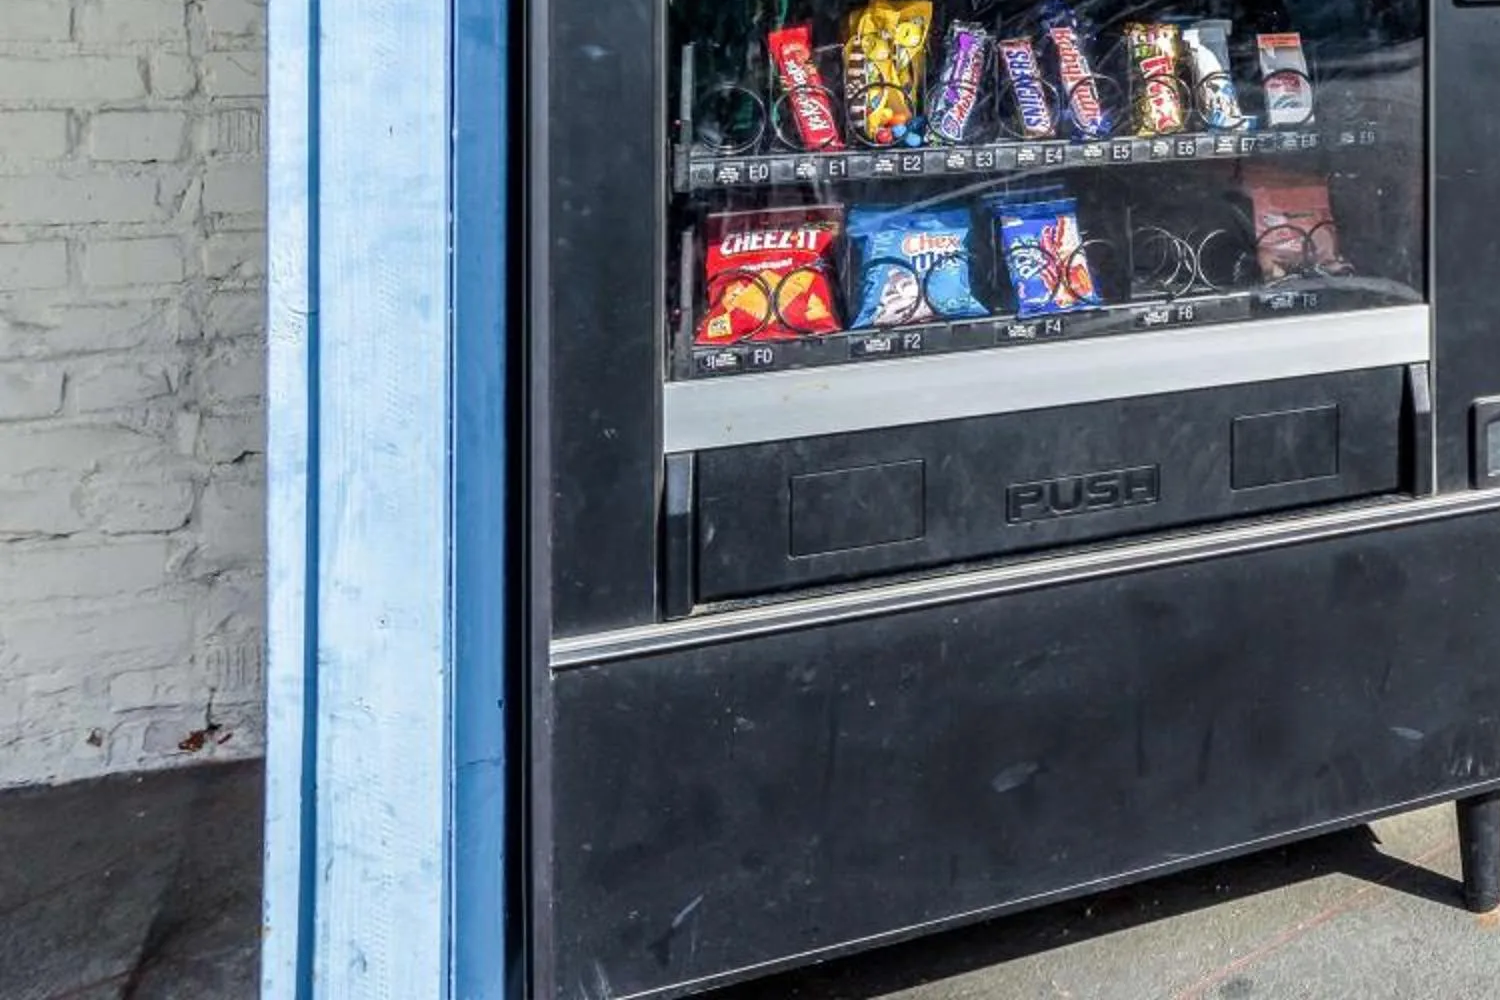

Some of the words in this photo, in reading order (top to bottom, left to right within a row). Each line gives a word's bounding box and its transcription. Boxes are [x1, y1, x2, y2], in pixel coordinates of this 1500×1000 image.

[1006, 49, 1043, 128] SNICKERS
[1113, 144, 1130, 159] E5
[1177, 141, 1194, 156] E6
[1241, 138, 1255, 152] E7
[976, 152, 993, 167] E3
[1046, 149, 1062, 163] E4
[829, 160, 847, 175] E1
[903, 156, 921, 172] E2
[749, 164, 769, 180] E0
[902, 231, 960, 255] Chex
[1178, 306, 1193, 321] F6
[1045, 319, 1062, 335] F4
[904, 333, 921, 350] F2
[1011, 468, 1157, 519] PUSH
